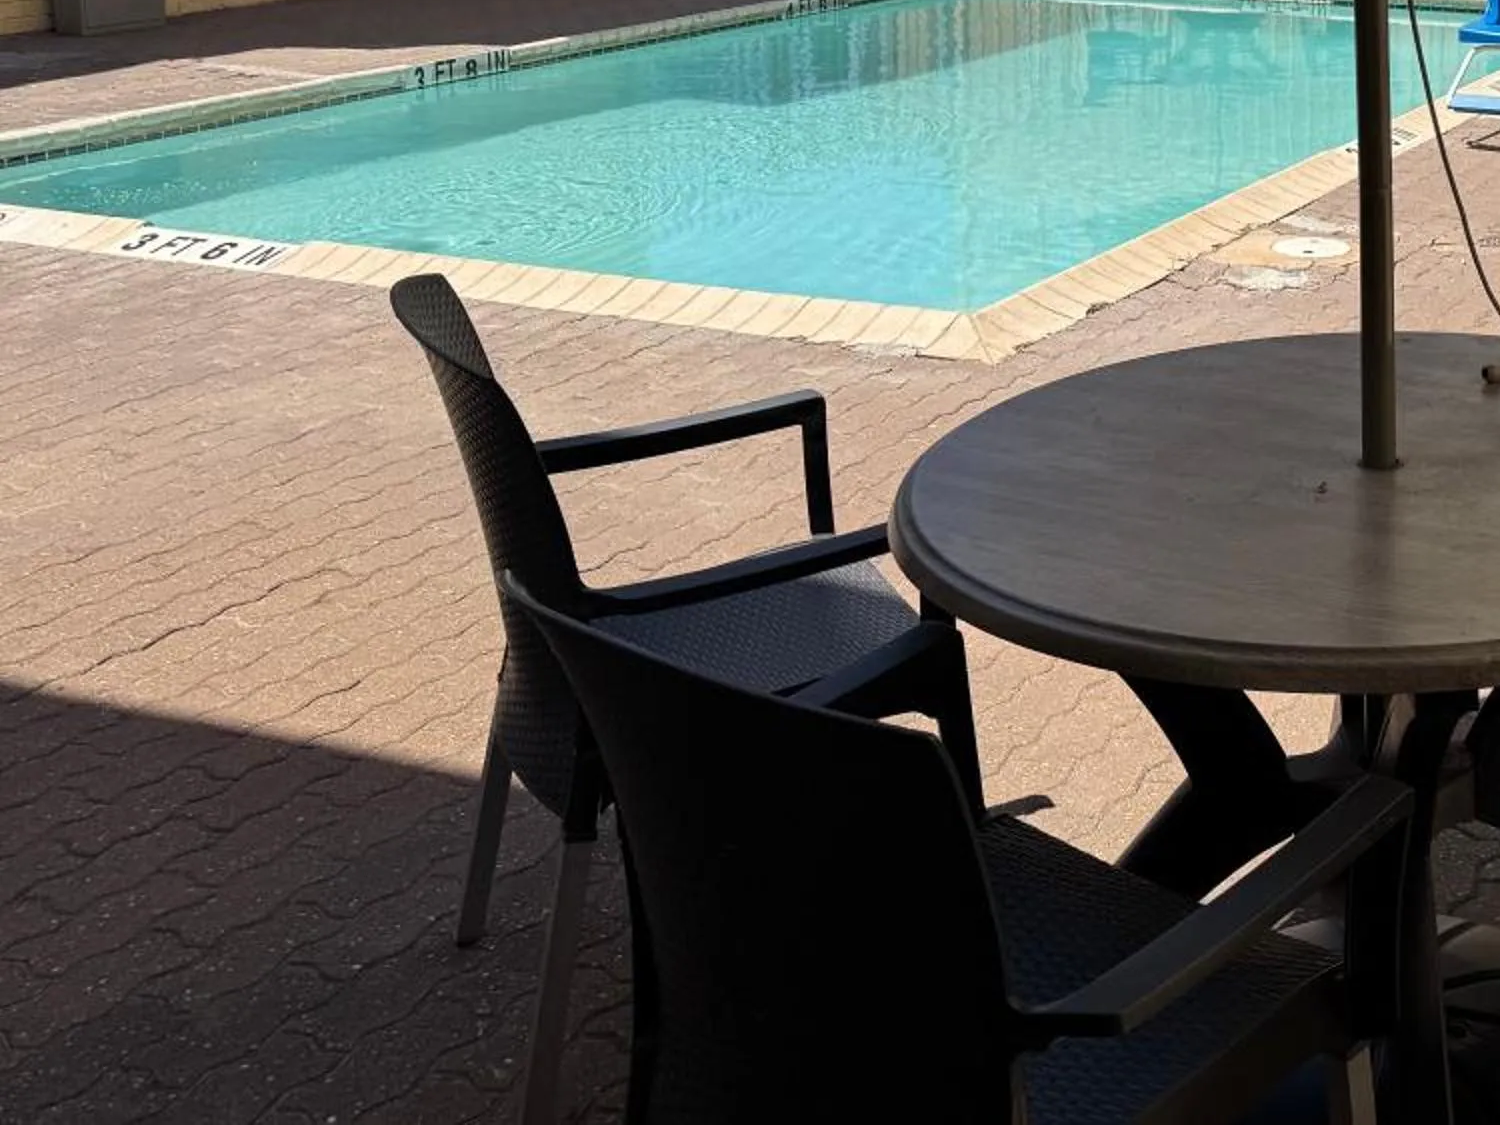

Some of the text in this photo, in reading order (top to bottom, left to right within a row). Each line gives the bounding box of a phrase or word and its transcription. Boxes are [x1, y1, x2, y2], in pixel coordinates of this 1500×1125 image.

[434, 58, 457, 84] FT
[486, 48, 512, 72] IN
[121, 232, 287, 266] 3 FT 6 IN
